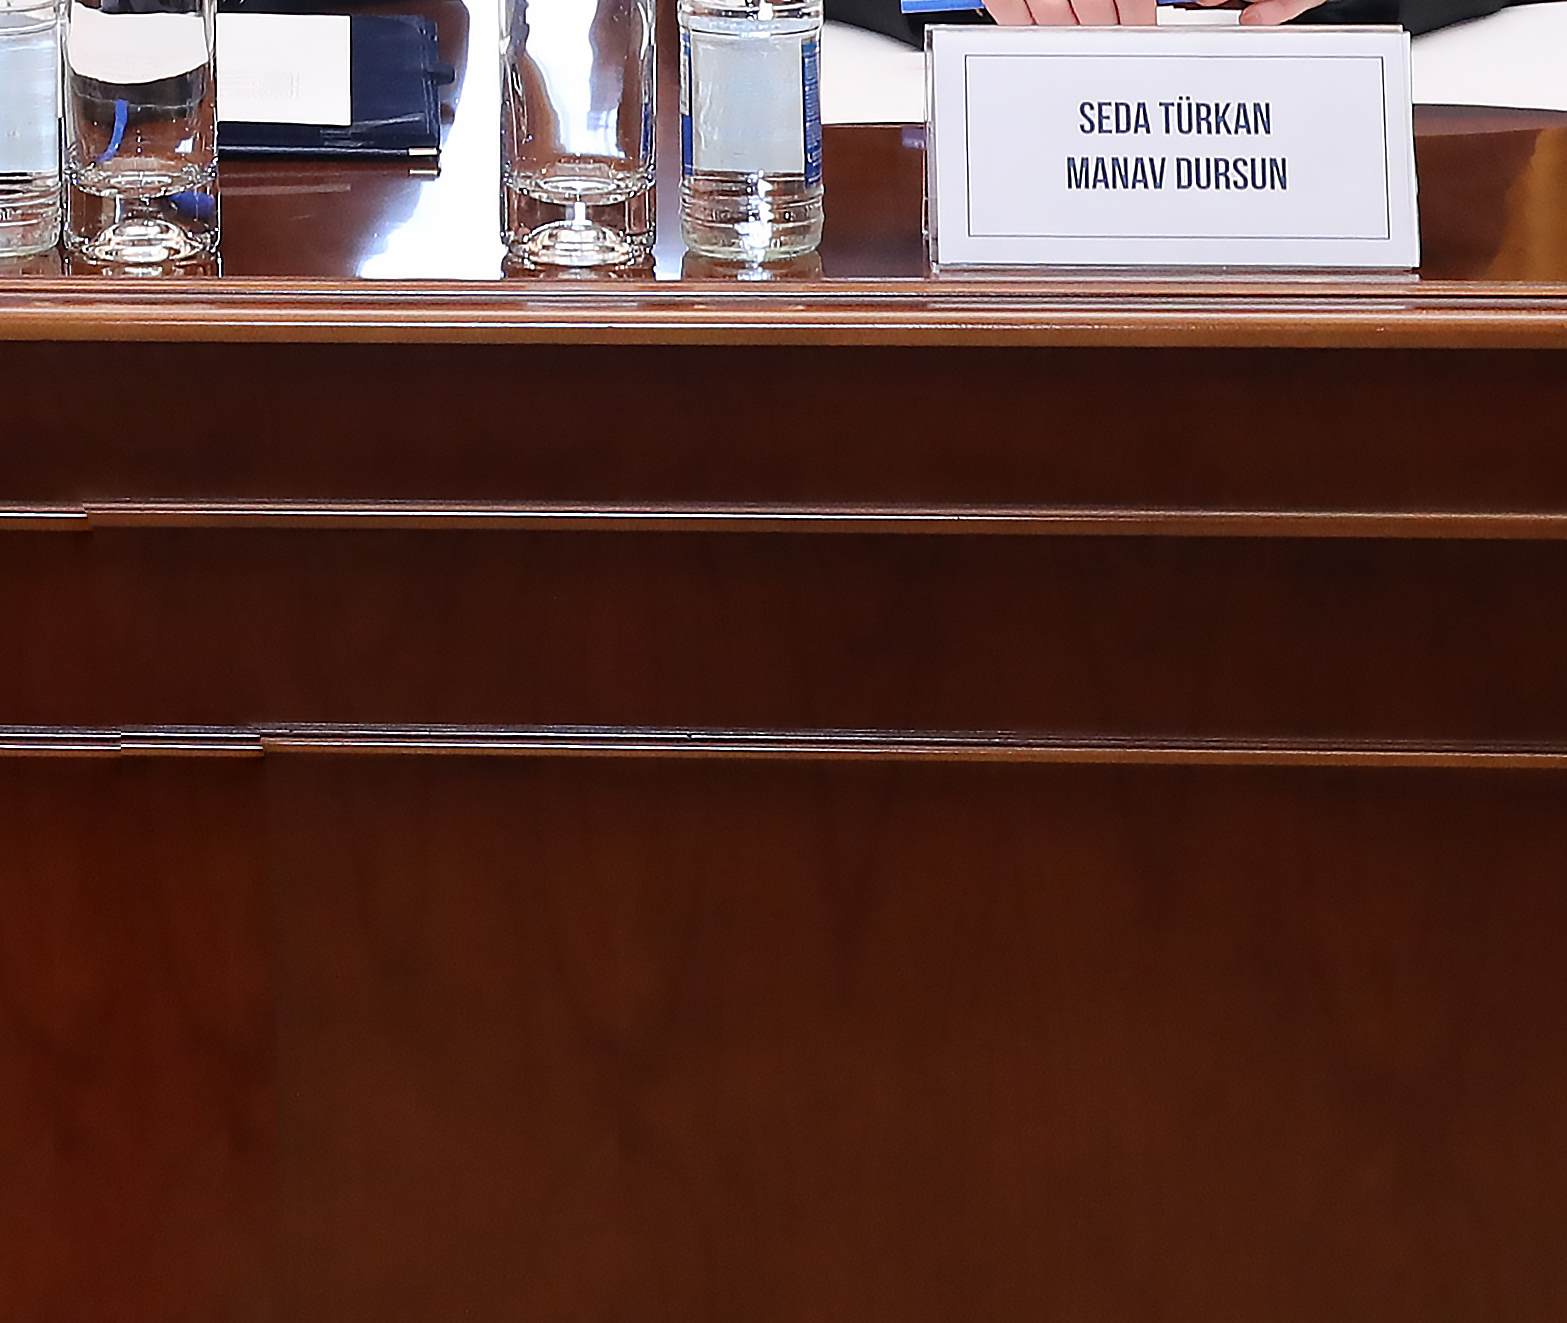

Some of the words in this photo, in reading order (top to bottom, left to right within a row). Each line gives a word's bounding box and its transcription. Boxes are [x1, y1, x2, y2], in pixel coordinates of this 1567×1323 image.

[1079, 101, 1151, 135] SEDA
[1158, 95, 1271, 136] TÜRKAN
[1066, 156, 1167, 190] MANAV
[1175, 157, 1287, 191] DURSUN
